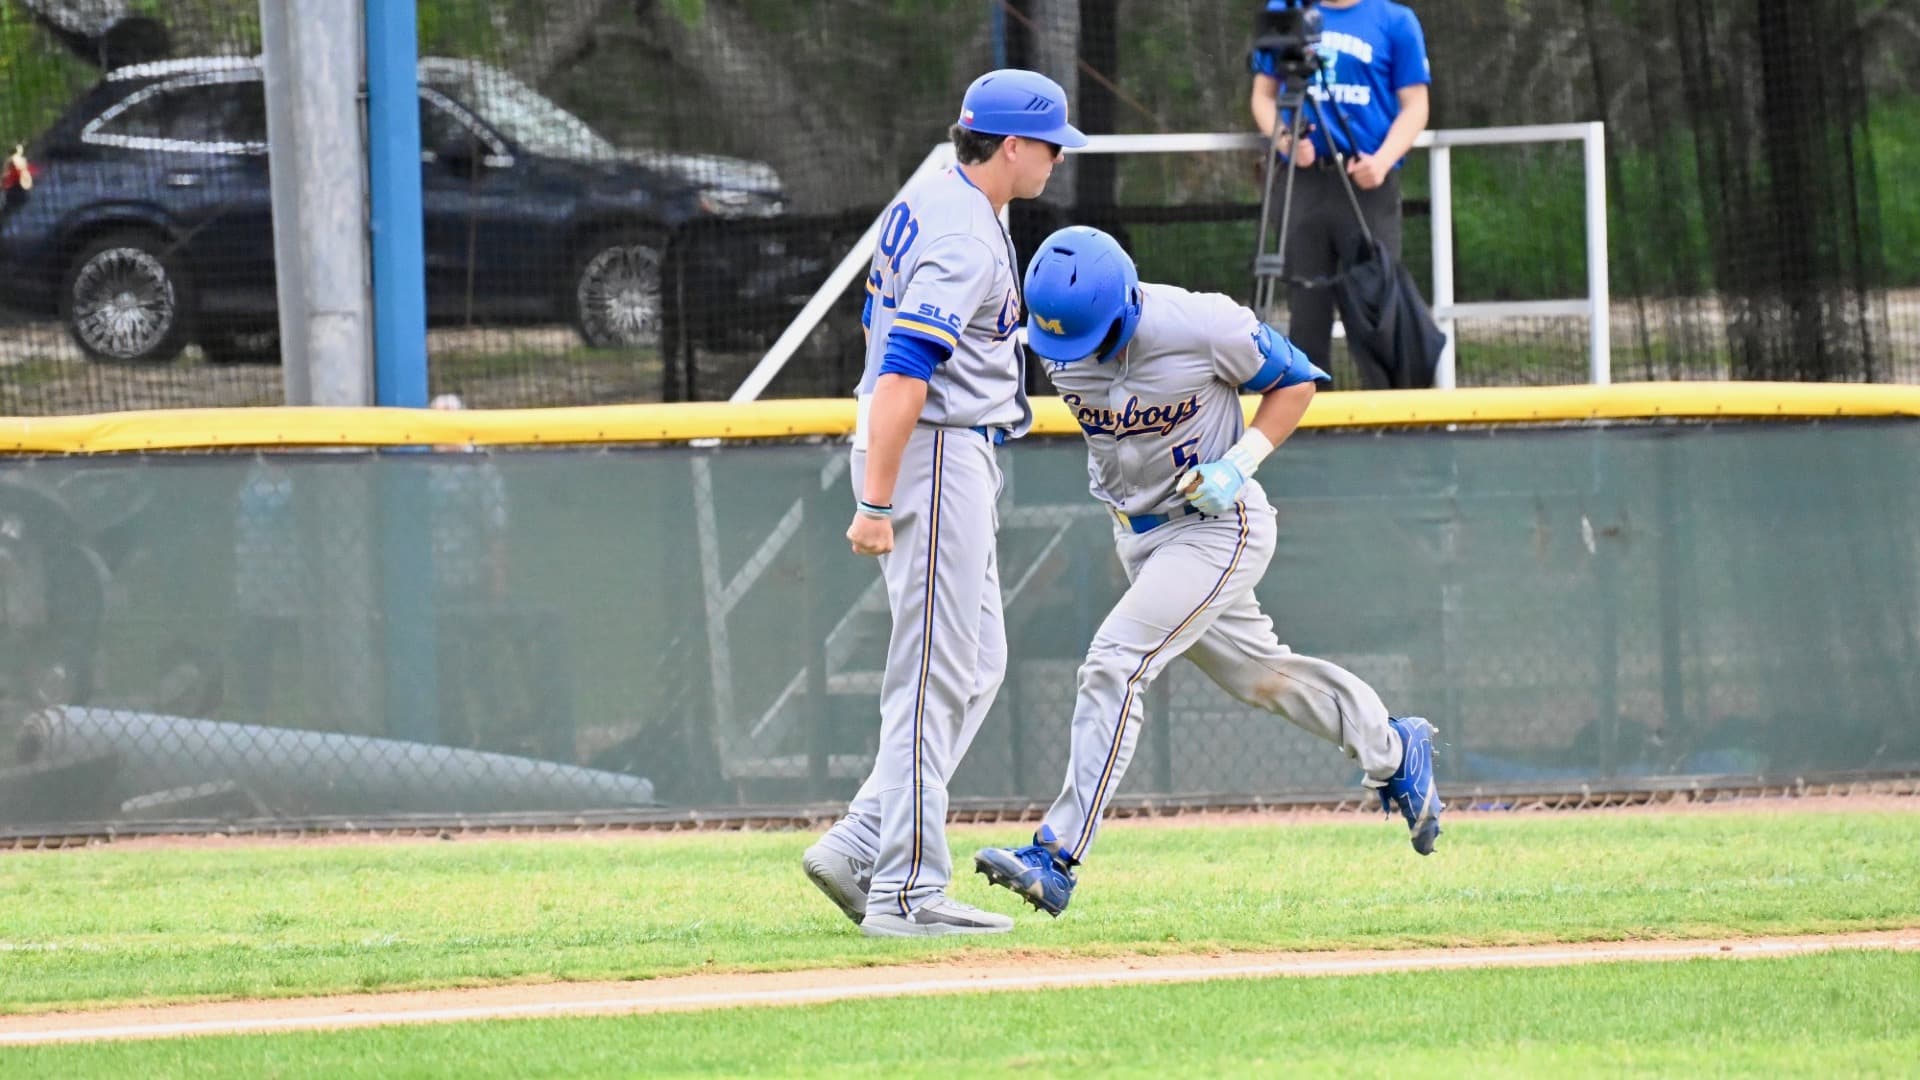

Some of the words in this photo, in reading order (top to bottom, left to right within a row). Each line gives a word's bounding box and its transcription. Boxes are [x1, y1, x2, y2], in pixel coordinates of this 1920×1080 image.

[917, 302, 961, 328] SLC
[1034, 313, 1065, 335] M
[1171, 436, 1200, 481] 5
